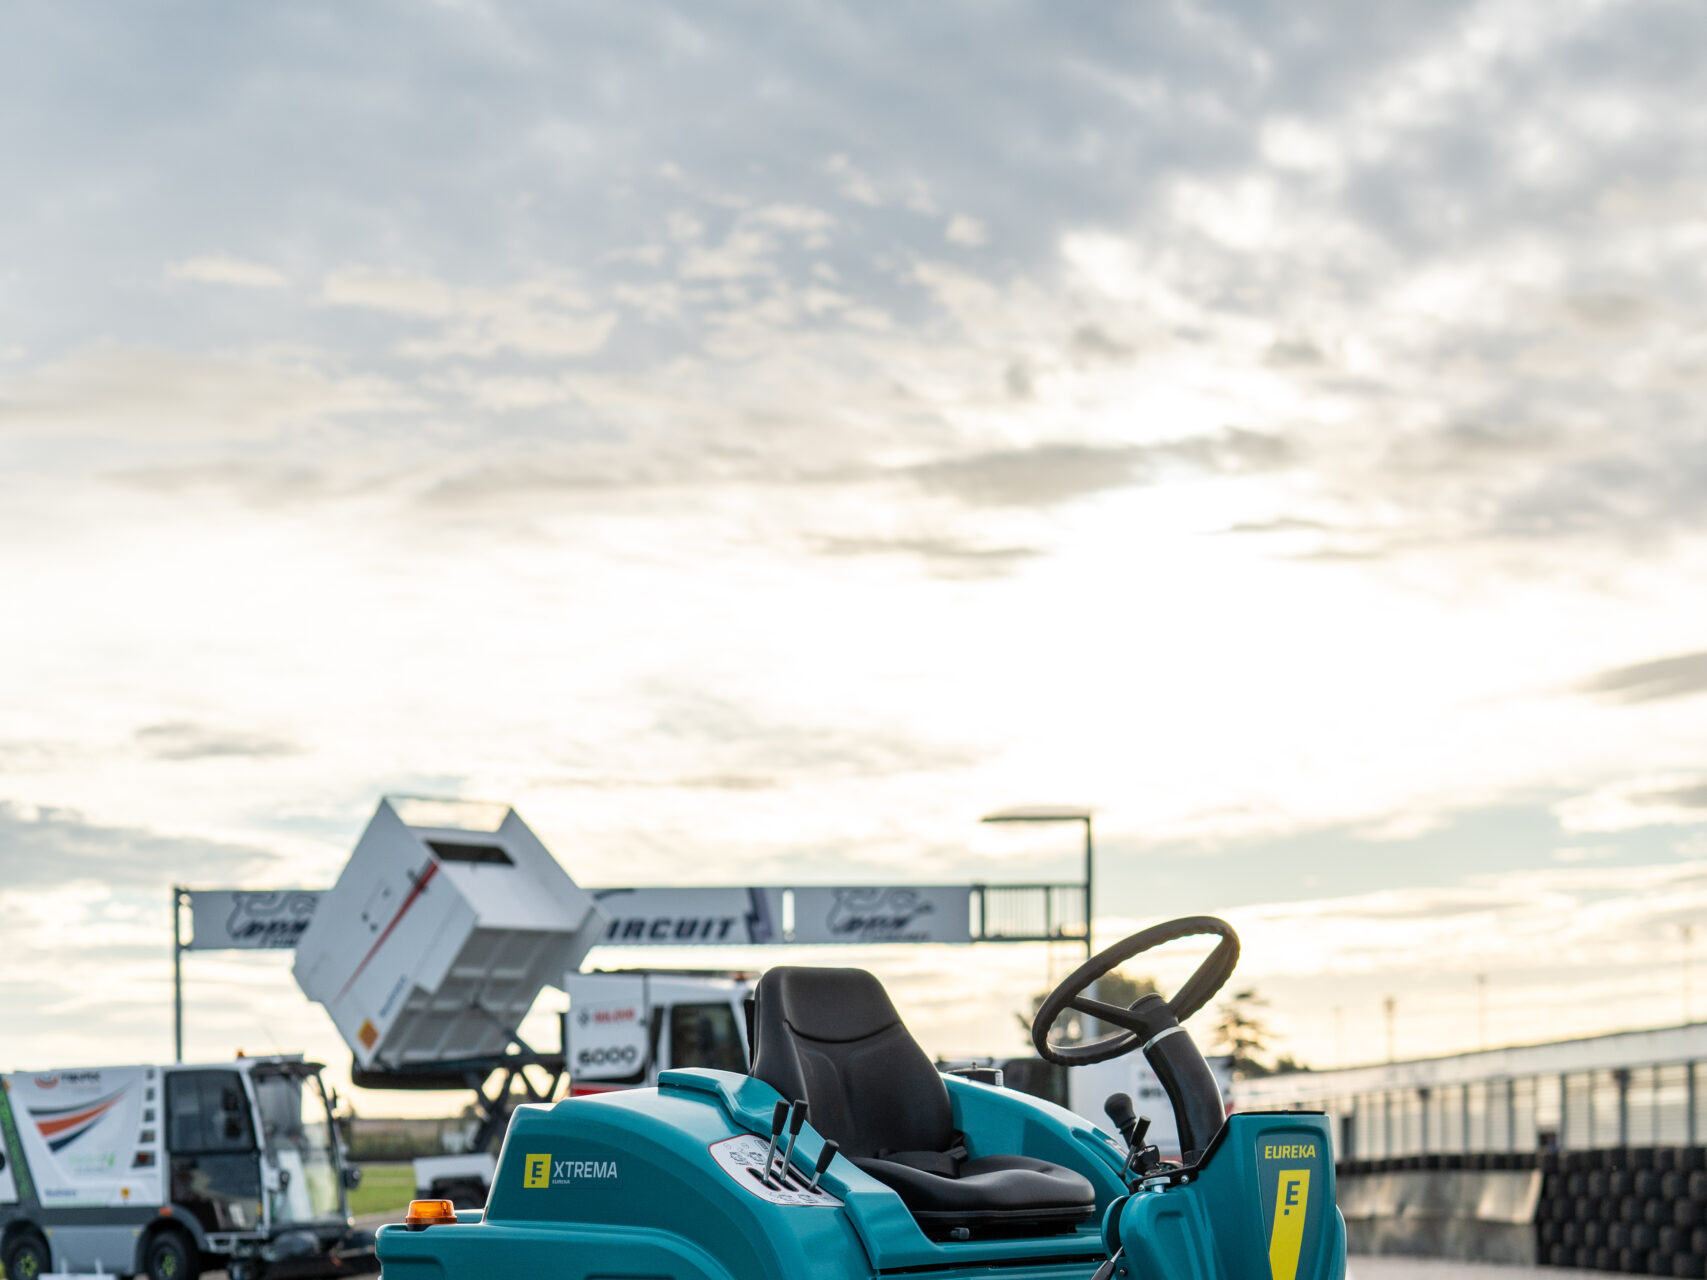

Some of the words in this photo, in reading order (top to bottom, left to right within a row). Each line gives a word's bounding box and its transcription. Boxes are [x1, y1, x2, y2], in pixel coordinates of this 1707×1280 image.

[605, 917, 737, 941] IRCUIT
[578, 1045, 637, 1067] 6000
[1264, 1145, 1316, 1159] EUREKA
